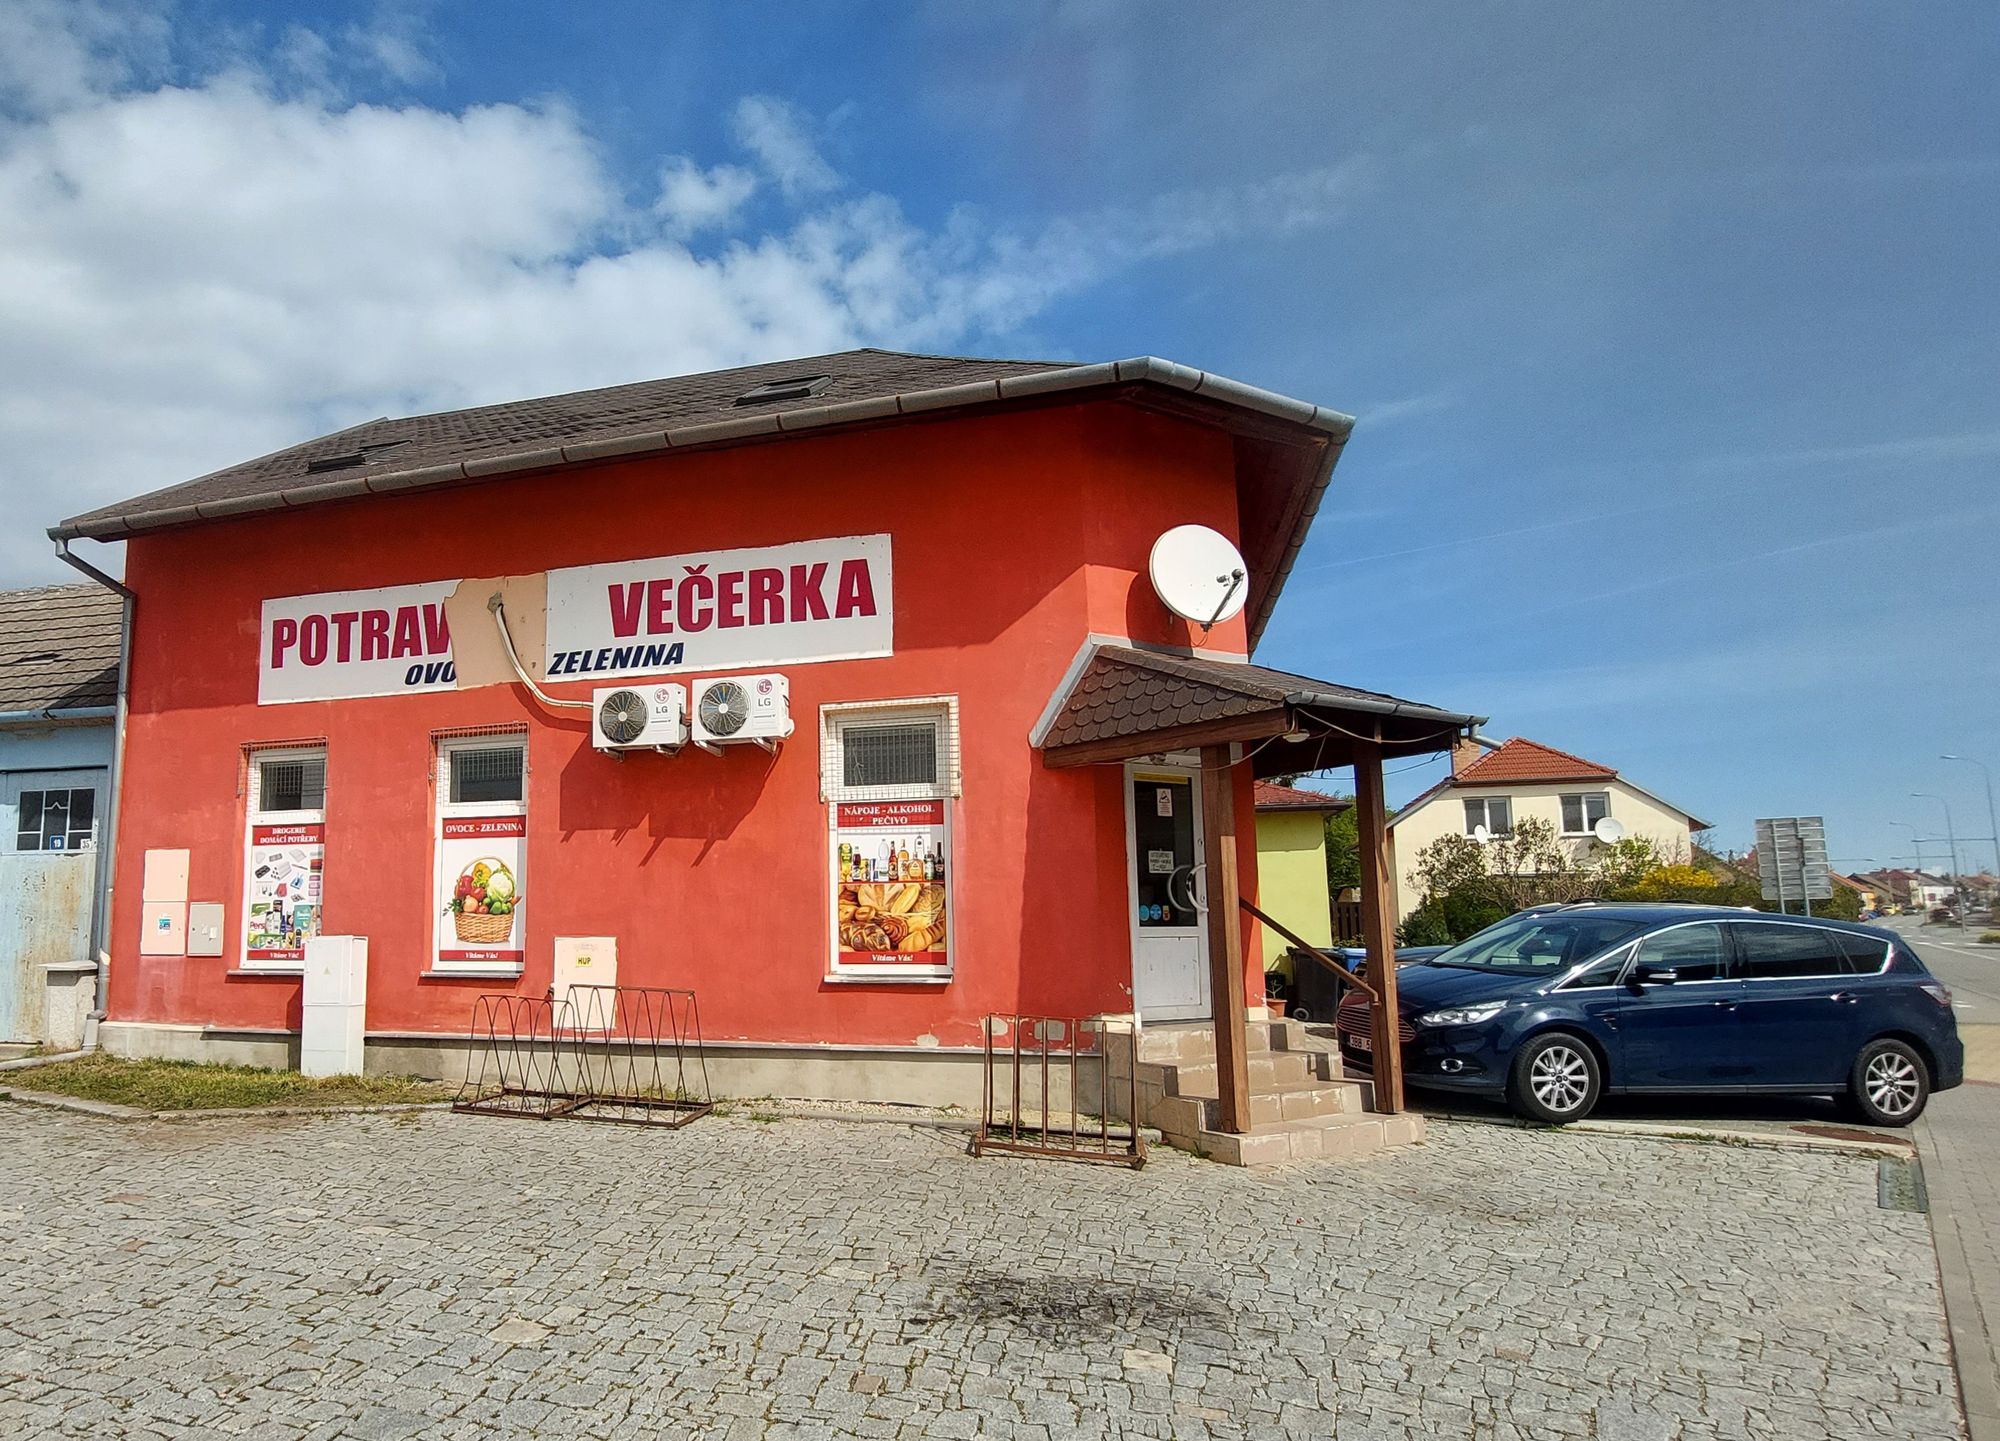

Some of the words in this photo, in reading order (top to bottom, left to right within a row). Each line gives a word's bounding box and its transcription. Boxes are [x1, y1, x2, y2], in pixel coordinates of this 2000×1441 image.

[271, 602, 451, 669] POTRAV
[607, 558, 877, 639] VEČERKA
[547, 642, 685, 675] ZELENINA
[758, 698, 772, 707] LG
[655, 706, 668, 714] LG
[844, 805, 881, 816] NÁPOJE
[887, 804, 935, 815] ALKOHOL
[872, 815, 908, 825] PEČIVO
[445, 823, 475, 833] OVOCE
[480, 822, 523, 833] ZELENINA
[578, 957, 592, 965] HUP
